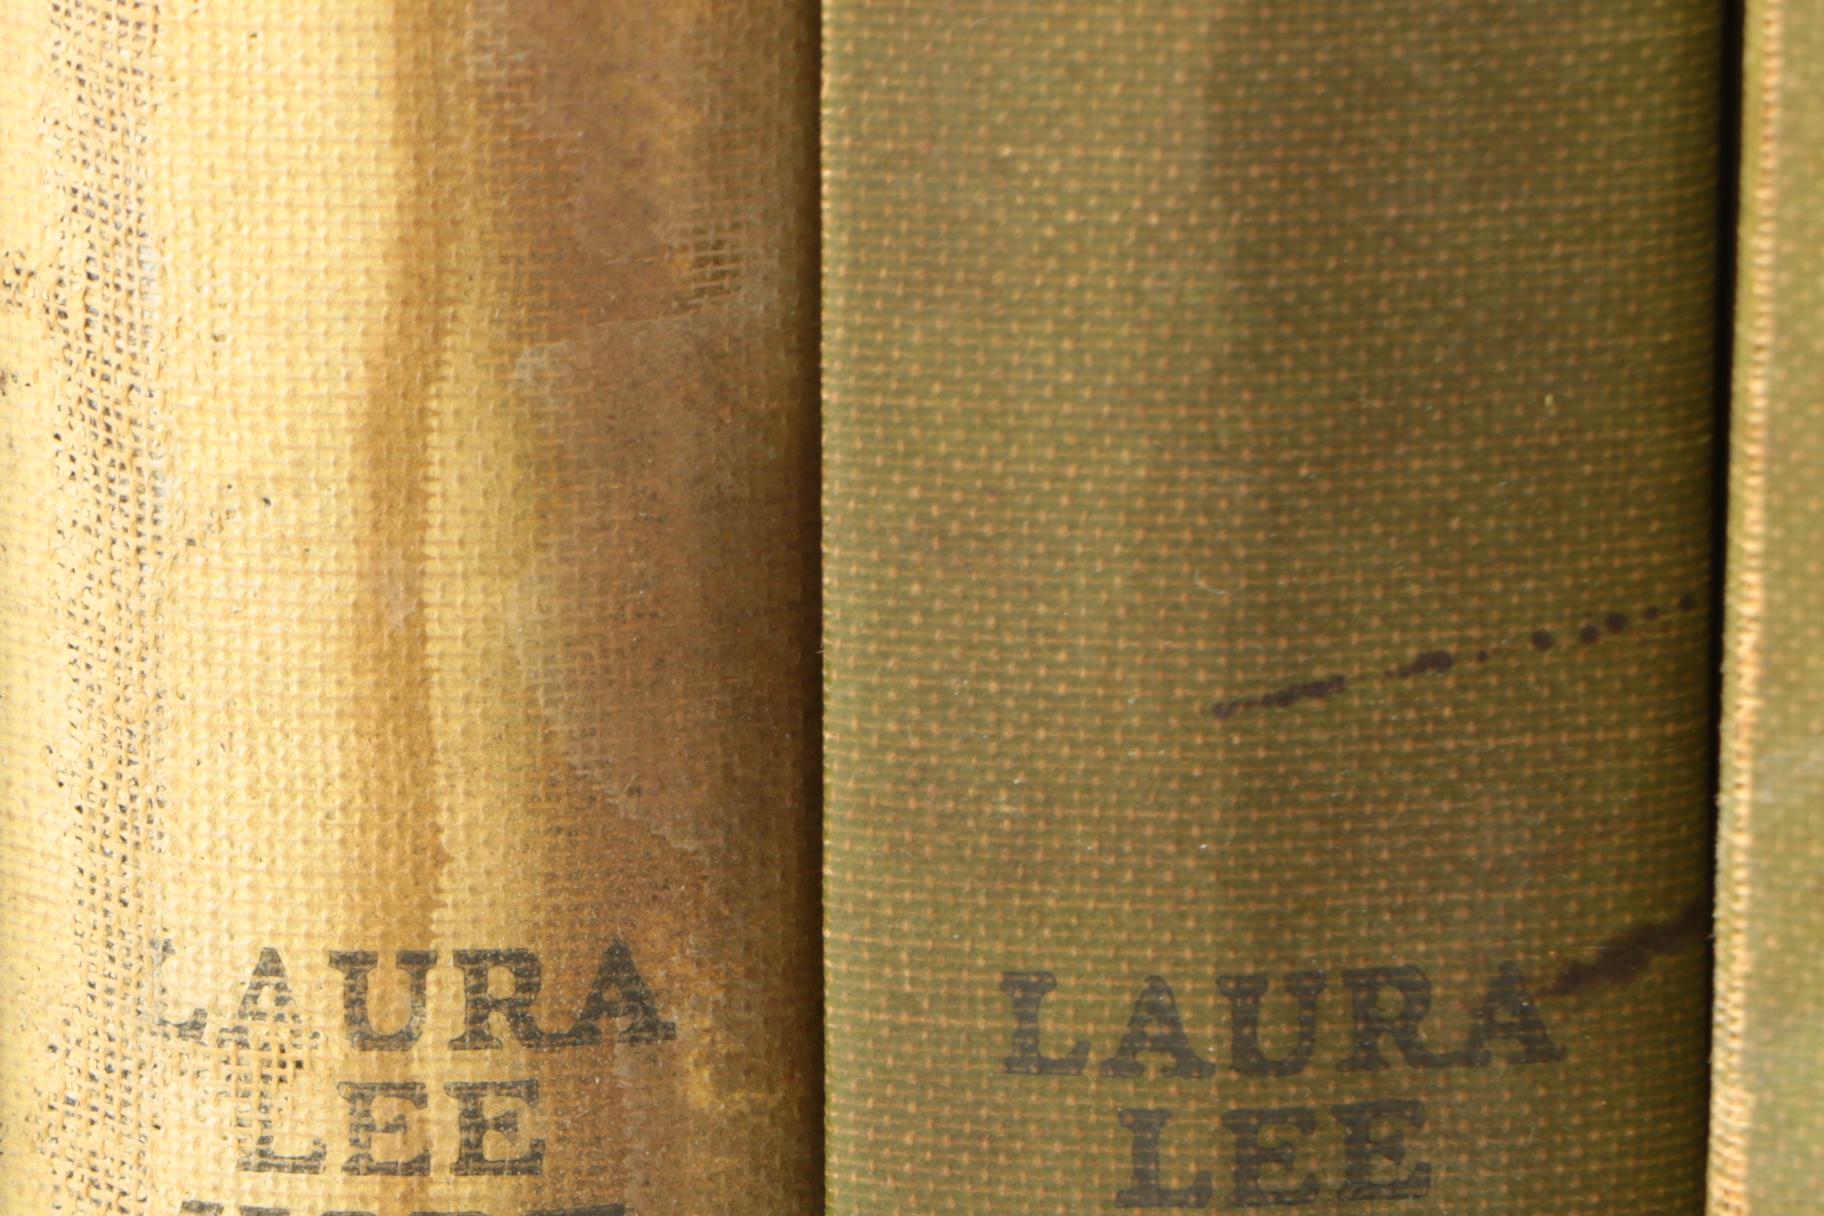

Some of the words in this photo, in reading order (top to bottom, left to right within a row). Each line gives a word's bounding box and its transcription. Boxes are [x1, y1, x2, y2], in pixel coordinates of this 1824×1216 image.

[999, 961, 1566, 1079] LAURA
[236, 1079, 546, 1176] LEE
[1115, 1100, 1432, 1208] LEE
